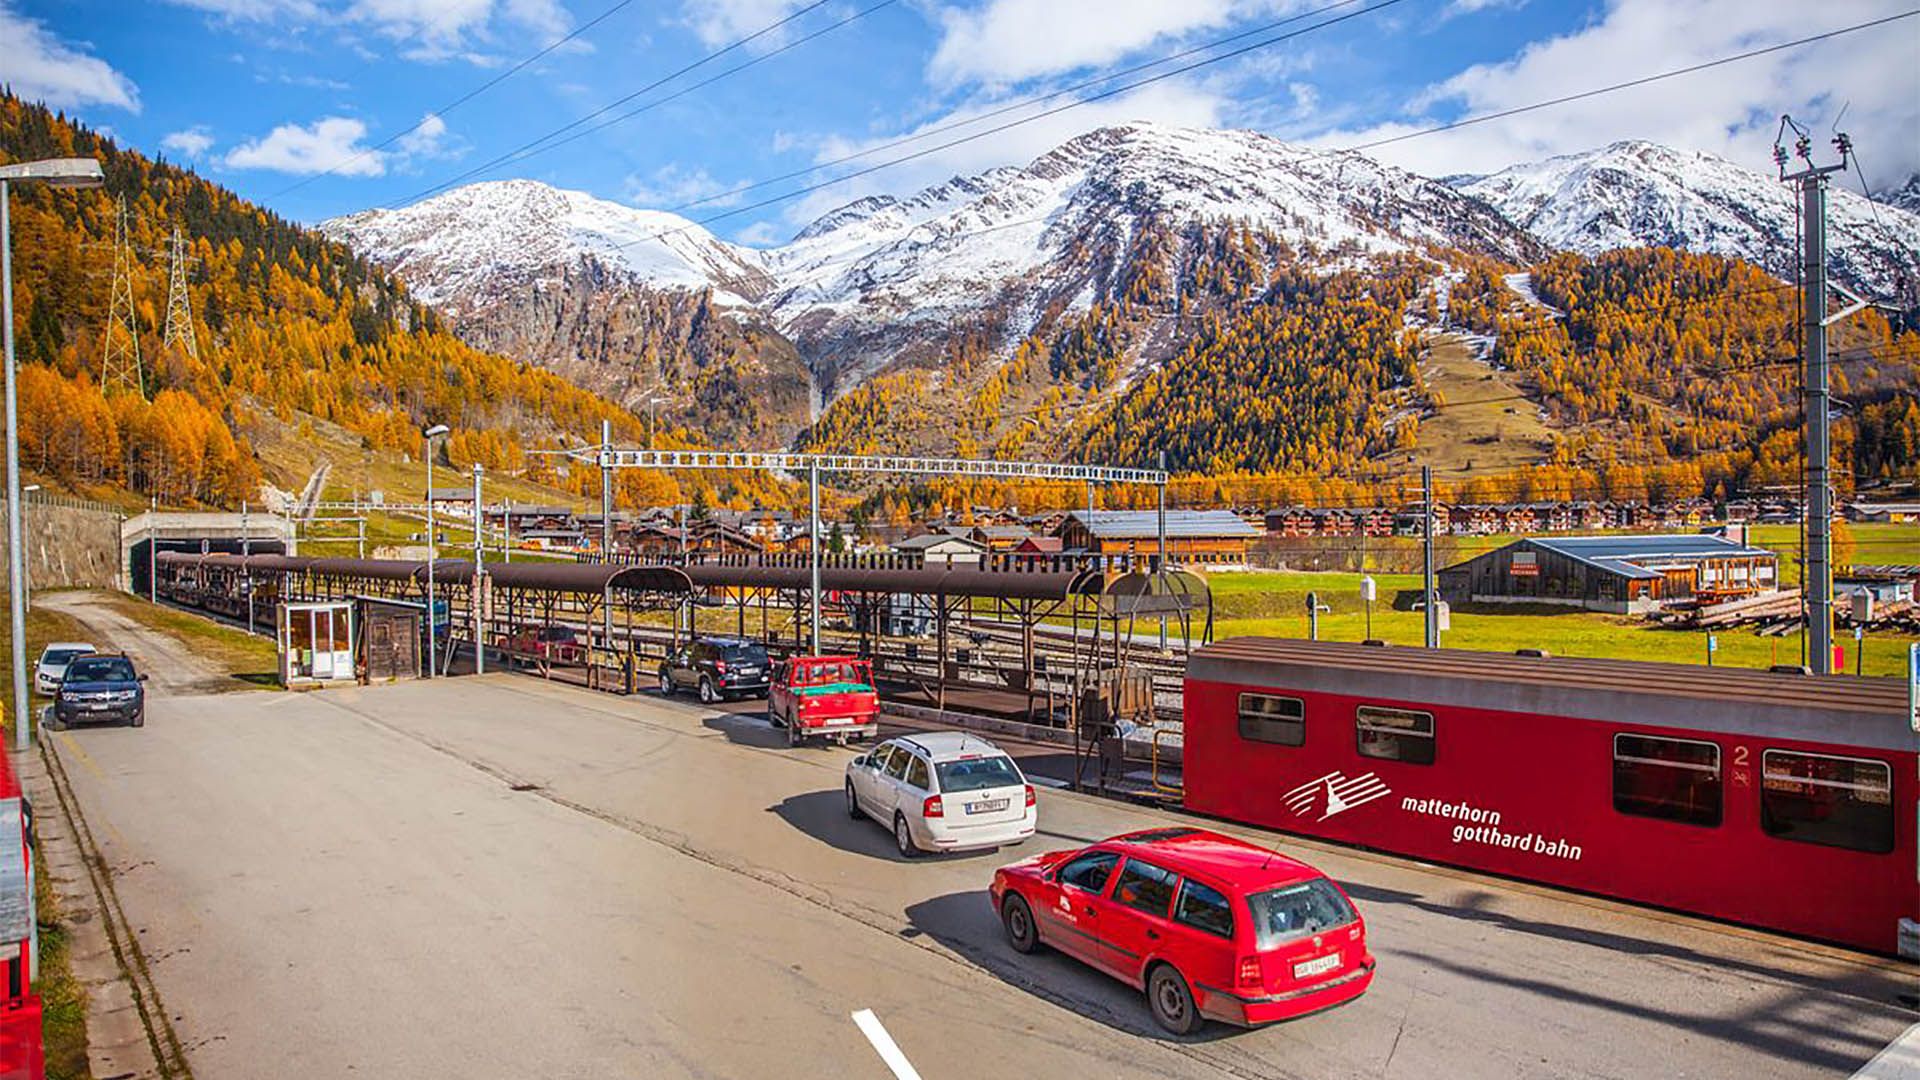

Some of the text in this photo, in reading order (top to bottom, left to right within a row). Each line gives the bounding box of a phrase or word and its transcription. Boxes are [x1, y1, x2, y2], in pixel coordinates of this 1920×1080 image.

[1734, 746, 1749, 765] 2
[1402, 797, 1500, 825] matterhorn
[1452, 825, 1582, 860] gotthard bahn
